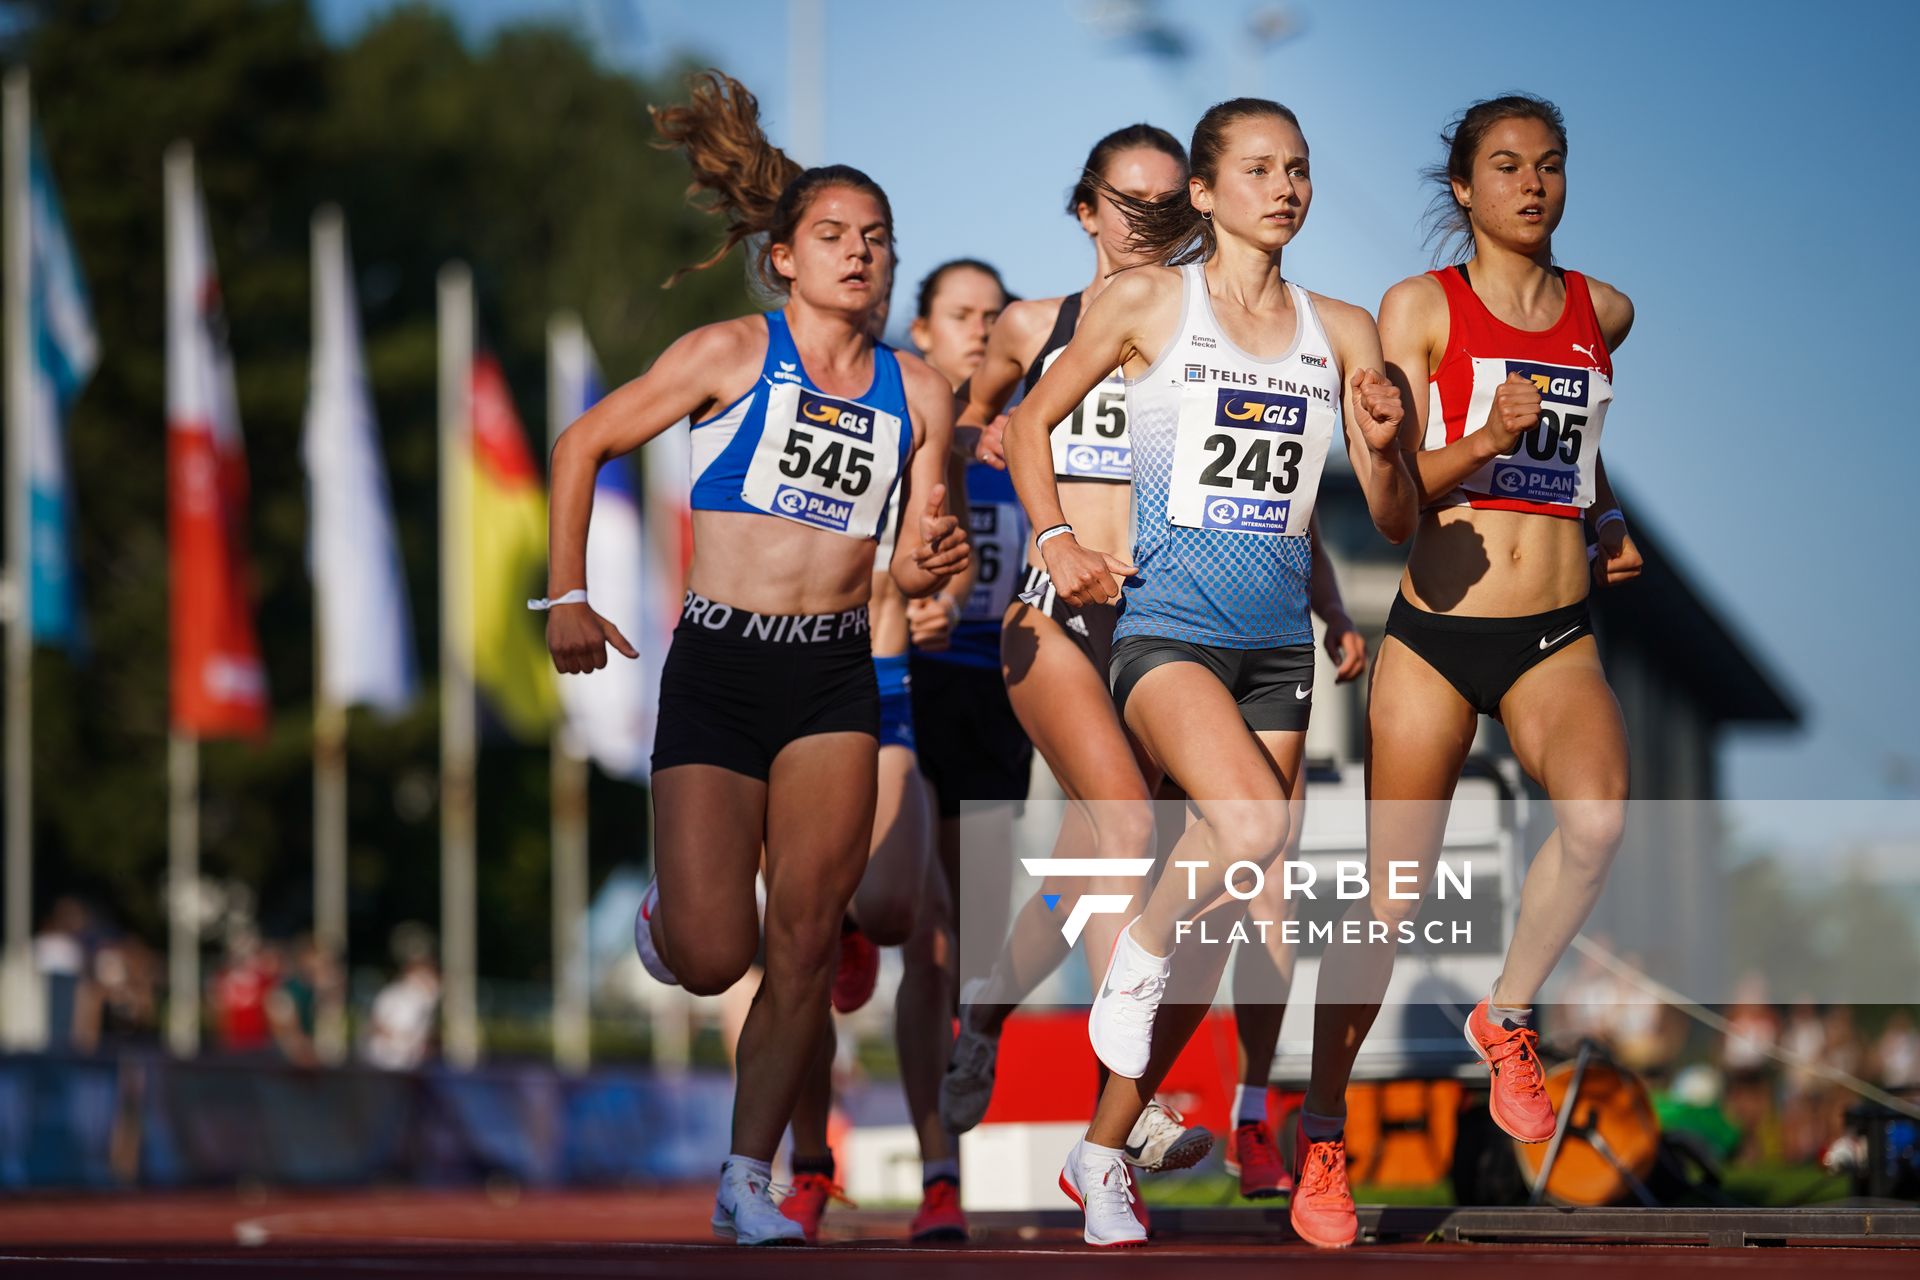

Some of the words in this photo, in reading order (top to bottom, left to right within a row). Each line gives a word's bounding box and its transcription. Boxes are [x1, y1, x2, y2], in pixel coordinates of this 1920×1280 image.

[1192, 335, 1216, 343] Emma
[1210, 369, 1258, 386] TELIS
[1268, 377, 1330, 402] FINANZ
[1550, 377, 1583, 399] GLS
[838, 412, 868, 435] GLS
[1263, 405, 1300, 426] GLS
[1500, 408, 1588, 465] 05
[779, 428, 874, 496] 545
[1199, 434, 1304, 494] 243
[1529, 473, 1572, 492] PLAN
[807, 498, 850, 521] PLAN
[1242, 504, 1287, 522] PLAN
[1241, 521, 1284, 529] INTERNATIONAL
[742, 613, 835, 643] NIKE
